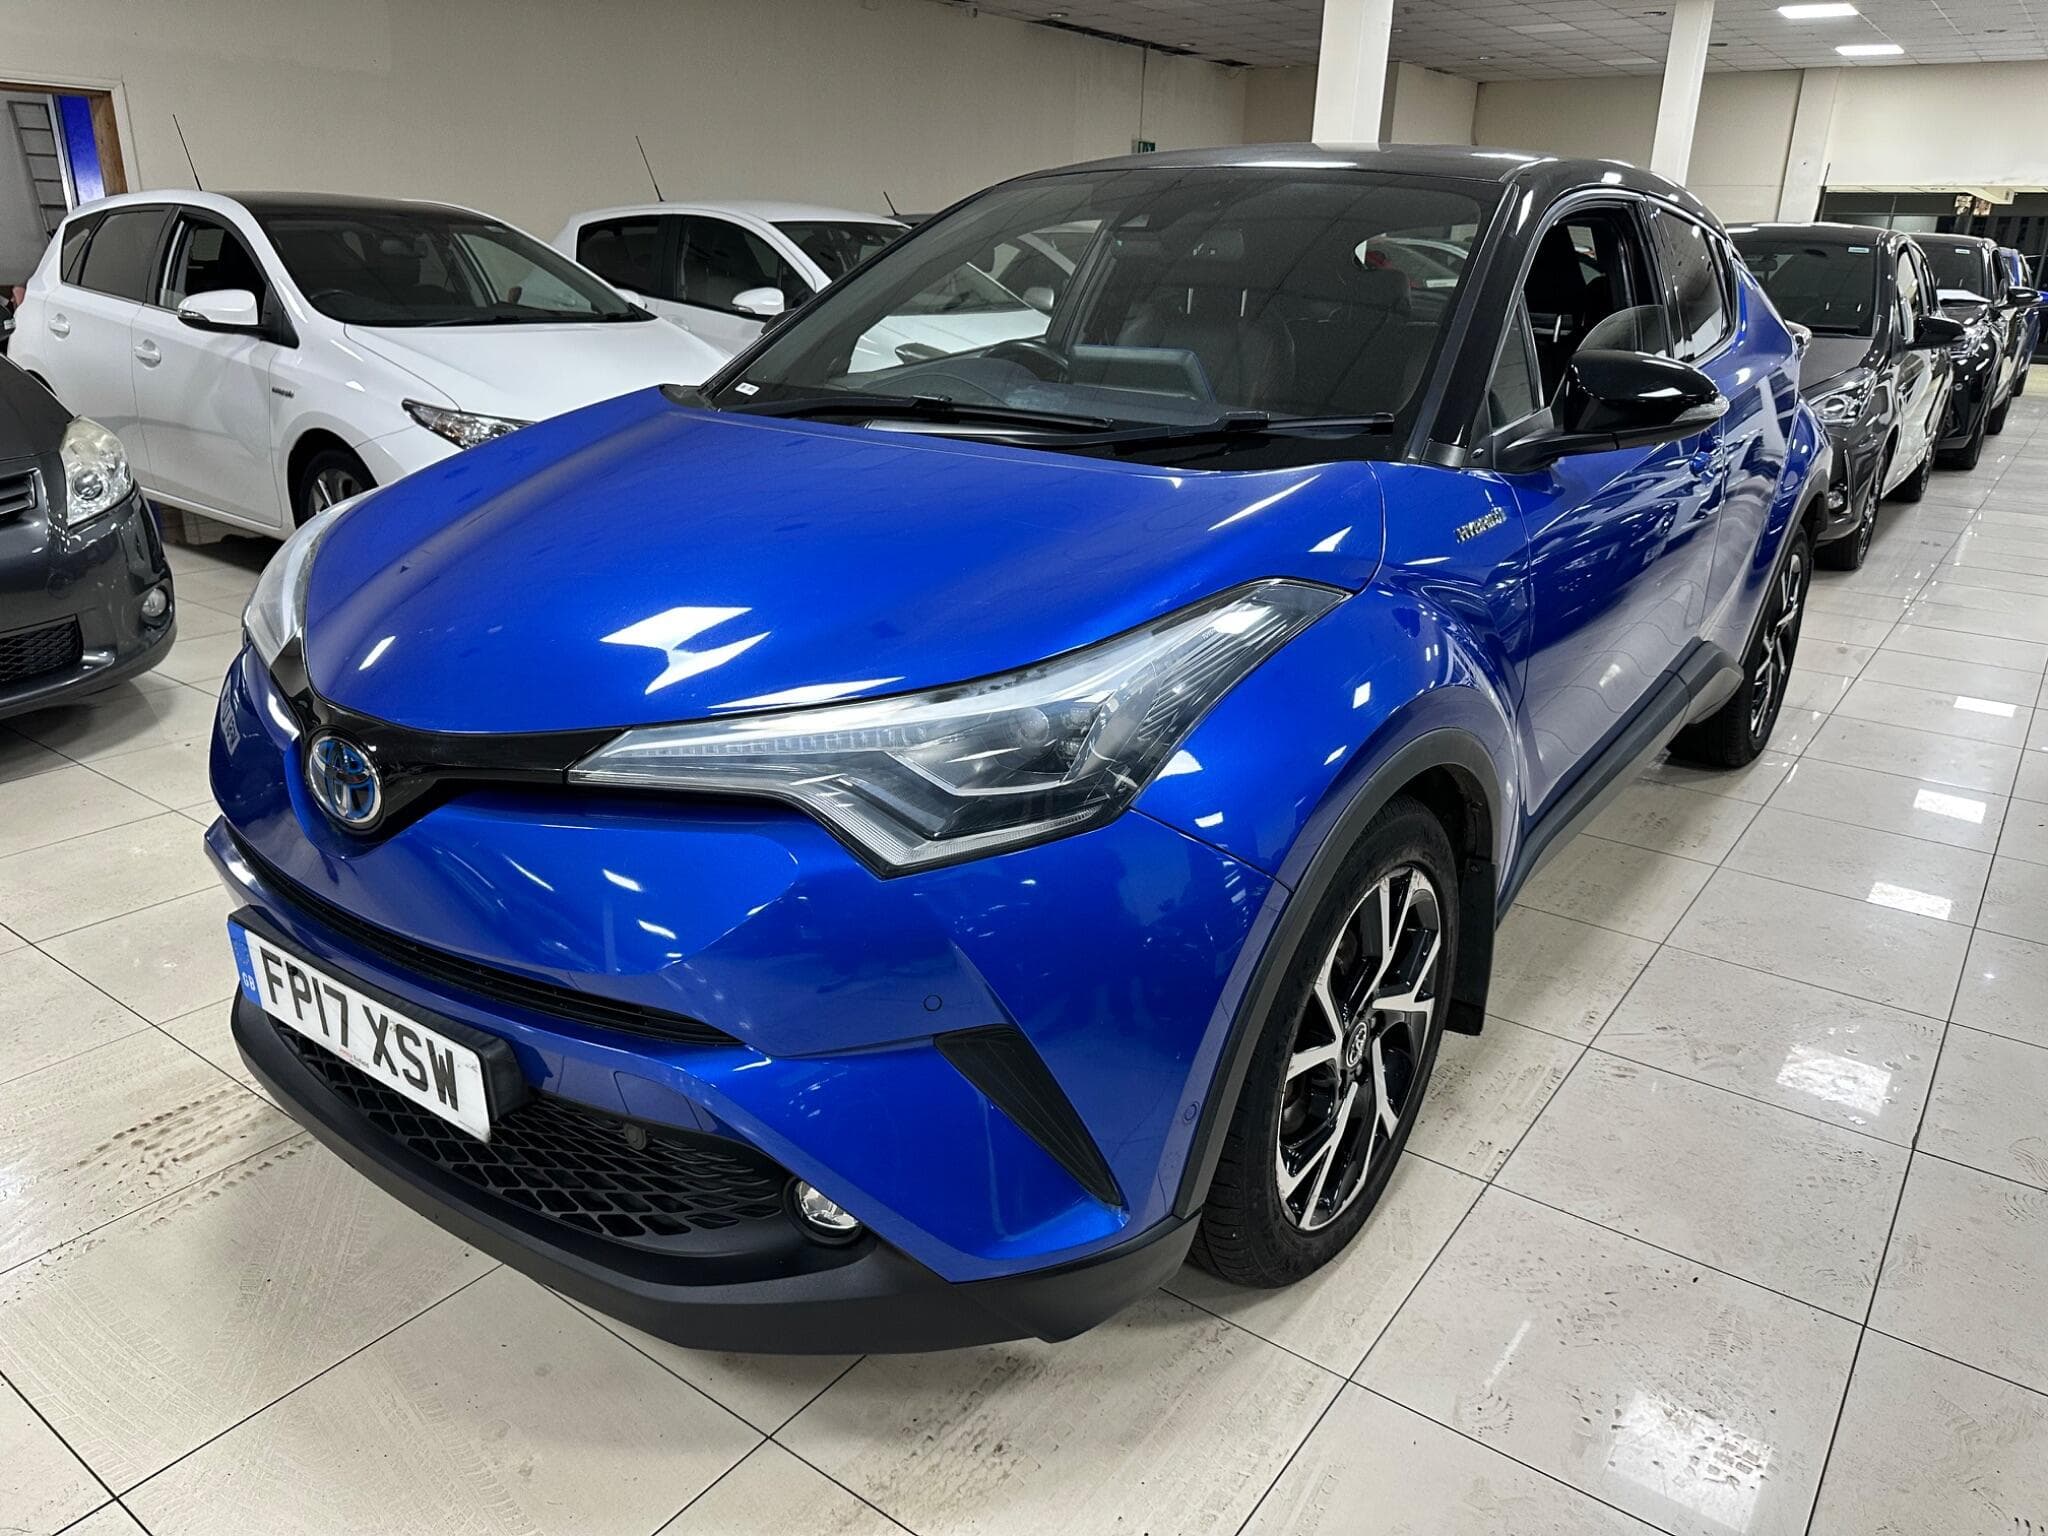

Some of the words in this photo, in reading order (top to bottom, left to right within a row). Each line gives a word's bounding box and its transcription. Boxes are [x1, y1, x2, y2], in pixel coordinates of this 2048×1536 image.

[241, 971, 255, 991] GB
[260, 946, 348, 1048] FP17
[362, 1004, 459, 1112] XSW
